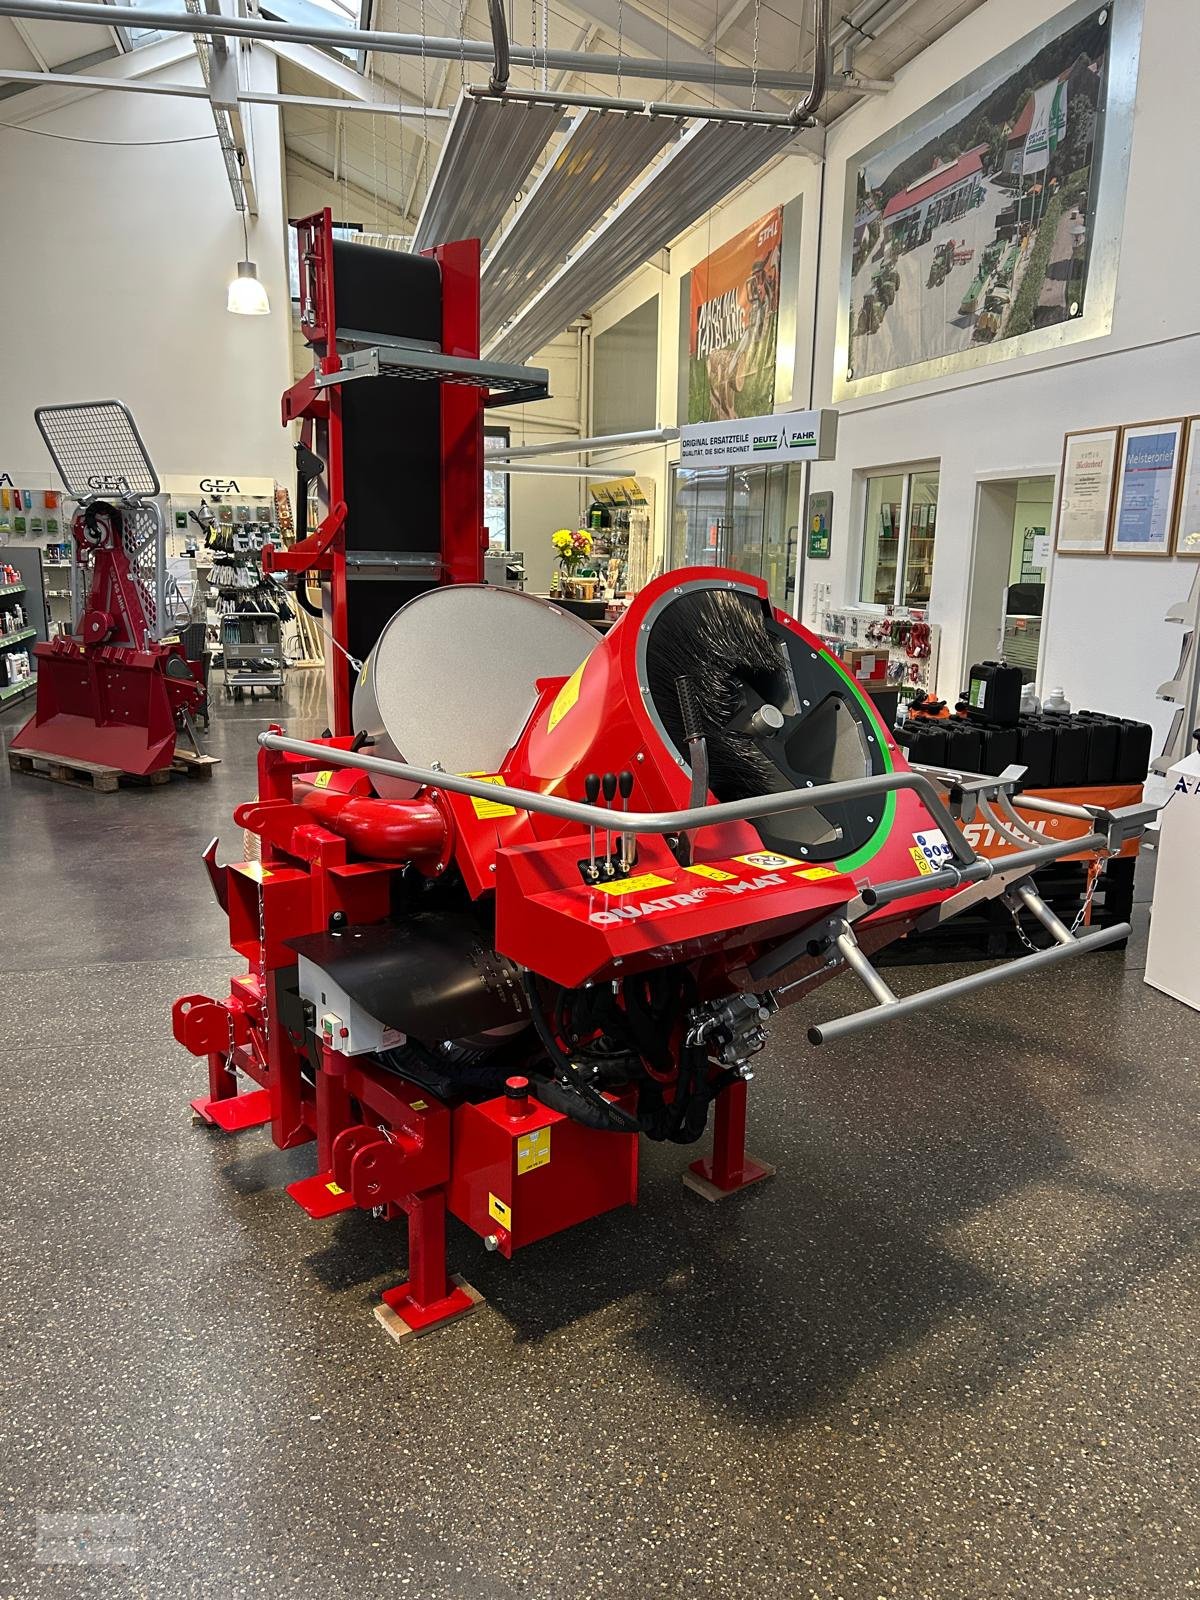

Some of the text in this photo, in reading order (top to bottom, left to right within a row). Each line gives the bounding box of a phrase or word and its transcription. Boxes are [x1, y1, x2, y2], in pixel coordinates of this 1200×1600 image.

[682, 433, 749, 448] ORIGINAL ERSATZTEILE
[753, 431, 815, 444] DEUTZ FAHR
[713, 447, 726, 455] SICH
[726, 445, 750, 454] RECHNET
[200, 478, 240, 493] GEA
[589, 873, 788, 924] QUATROMAT
